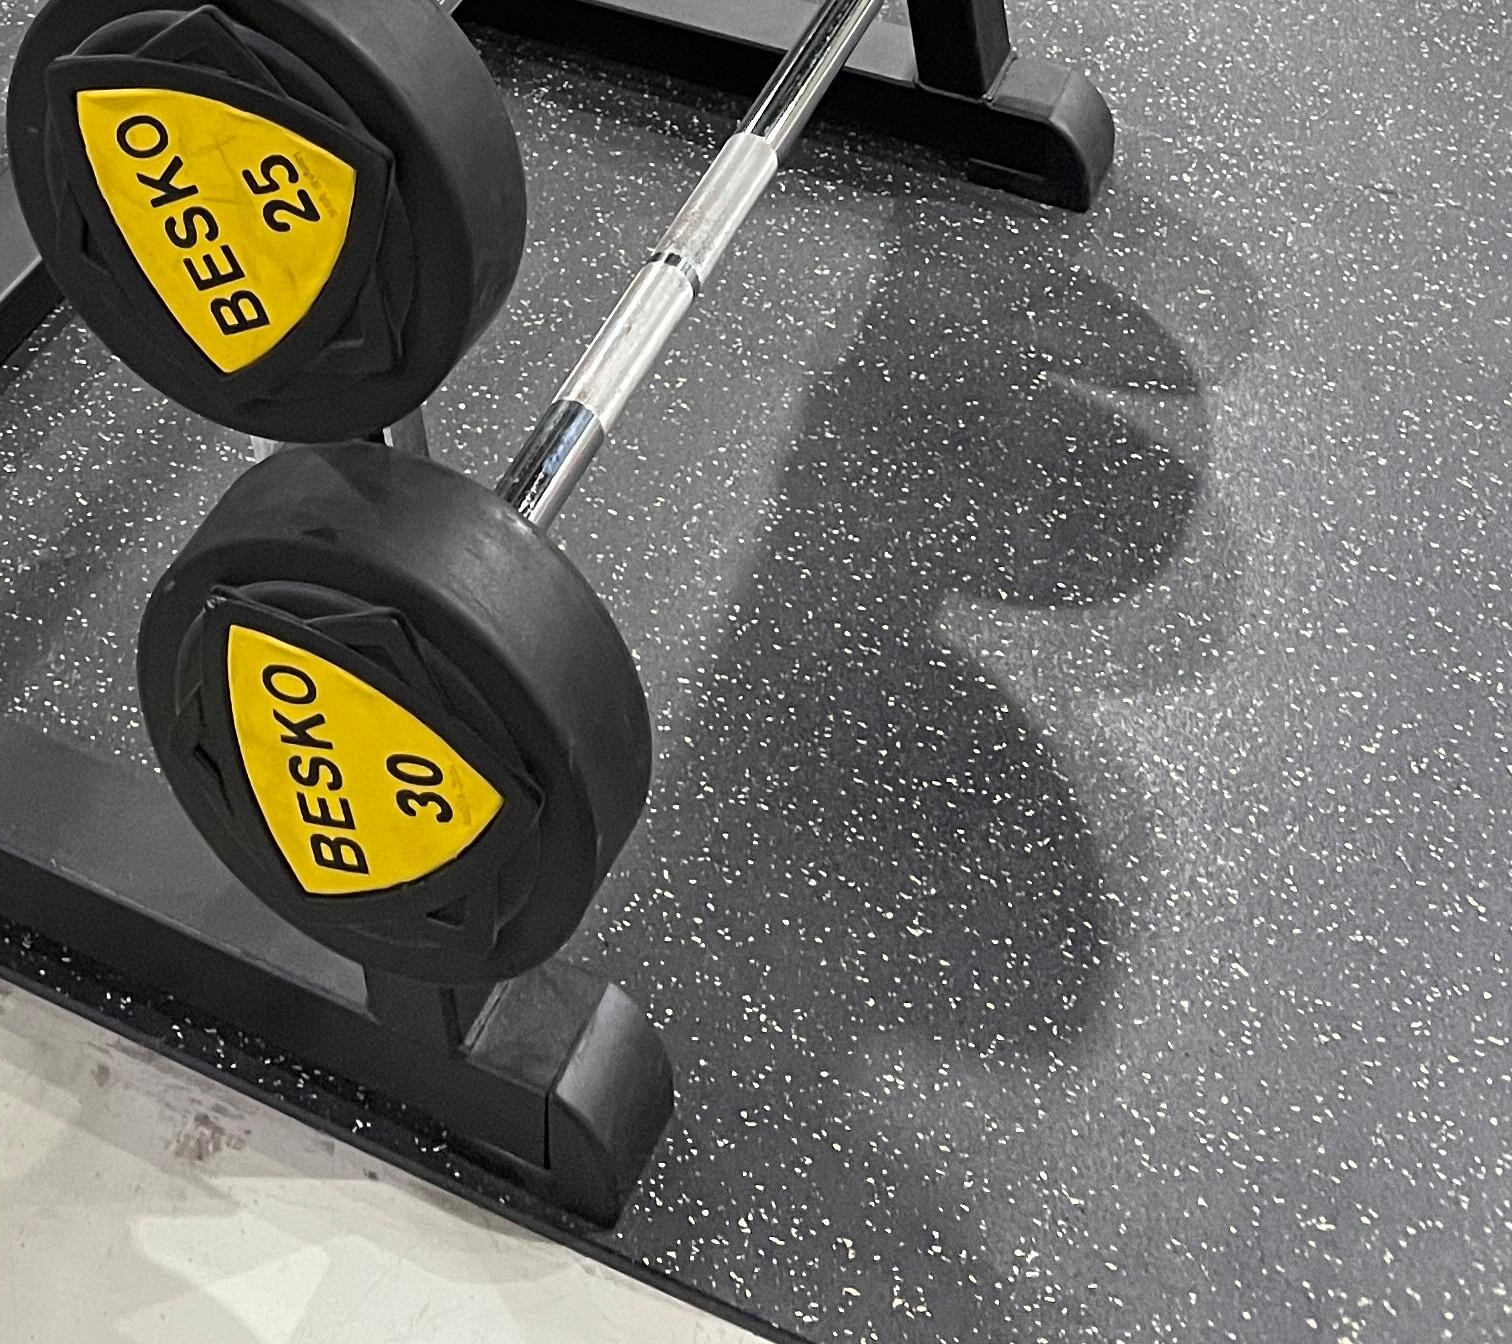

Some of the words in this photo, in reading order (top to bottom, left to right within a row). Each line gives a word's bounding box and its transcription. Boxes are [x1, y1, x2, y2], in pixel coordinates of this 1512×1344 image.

[115, 114, 271, 336] BESKO
[241, 154, 322, 233] 25
[261, 663, 370, 875] BESKO
[385, 752, 454, 824] 30
